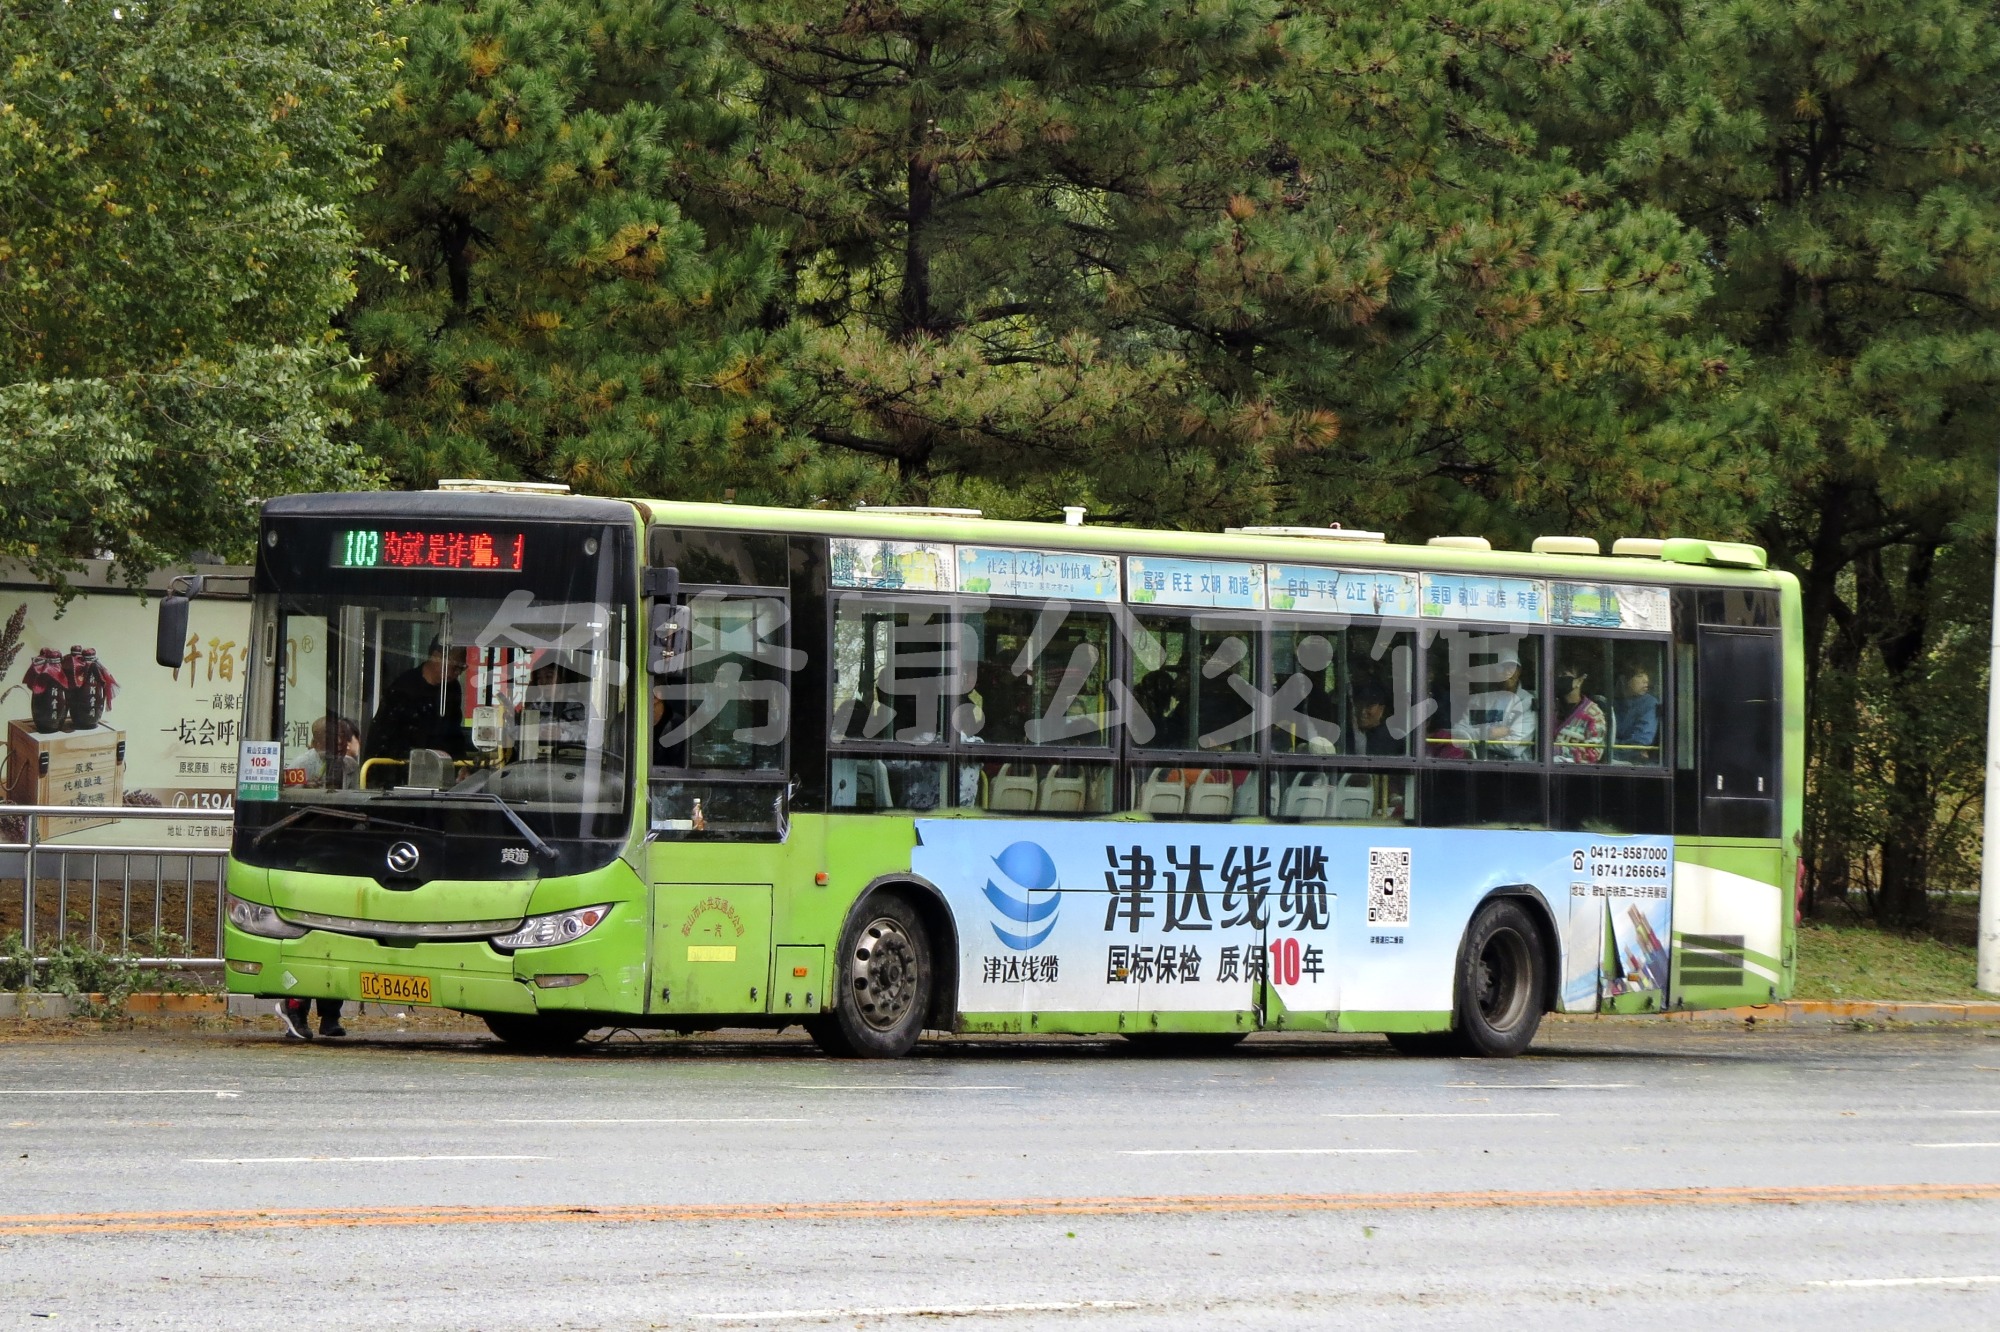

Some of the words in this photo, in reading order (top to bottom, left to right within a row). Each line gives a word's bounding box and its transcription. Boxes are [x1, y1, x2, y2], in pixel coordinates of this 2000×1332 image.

[344, 530, 378, 566] 103
[986, 556, 1092, 581] 社会主义核心价值观
[1143, 571, 1165, 591] 富强
[1172, 572, 1193, 592] 民主
[1200, 573, 1221, 594] 文明
[1228, 575, 1249, 596] 和谐
[1288, 578, 1309, 598] 自由
[1317, 579, 1338, 600] 平等
[1346, 581, 1367, 601] 公正
[1431, 585, 1452, 605] 爱国
[1459, 586, 1479, 607] 敬业
[1487, 588, 1507, 608] 诚信
[1517, 591, 1538, 611] 友善
[220, 762, 238, 775] 传统
[501, 848, 529, 865] 黄海
[1590, 846, 1668, 861] 0412-8587000
[1590, 864, 1667, 878] 18741266664
[1104, 845, 1331, 934] 津达线缆
[982, 954, 1060, 984] 津达线缆
[1106, 944, 1201, 985] 国标保检
[1216, 937, 1325, 986] 质保10年
